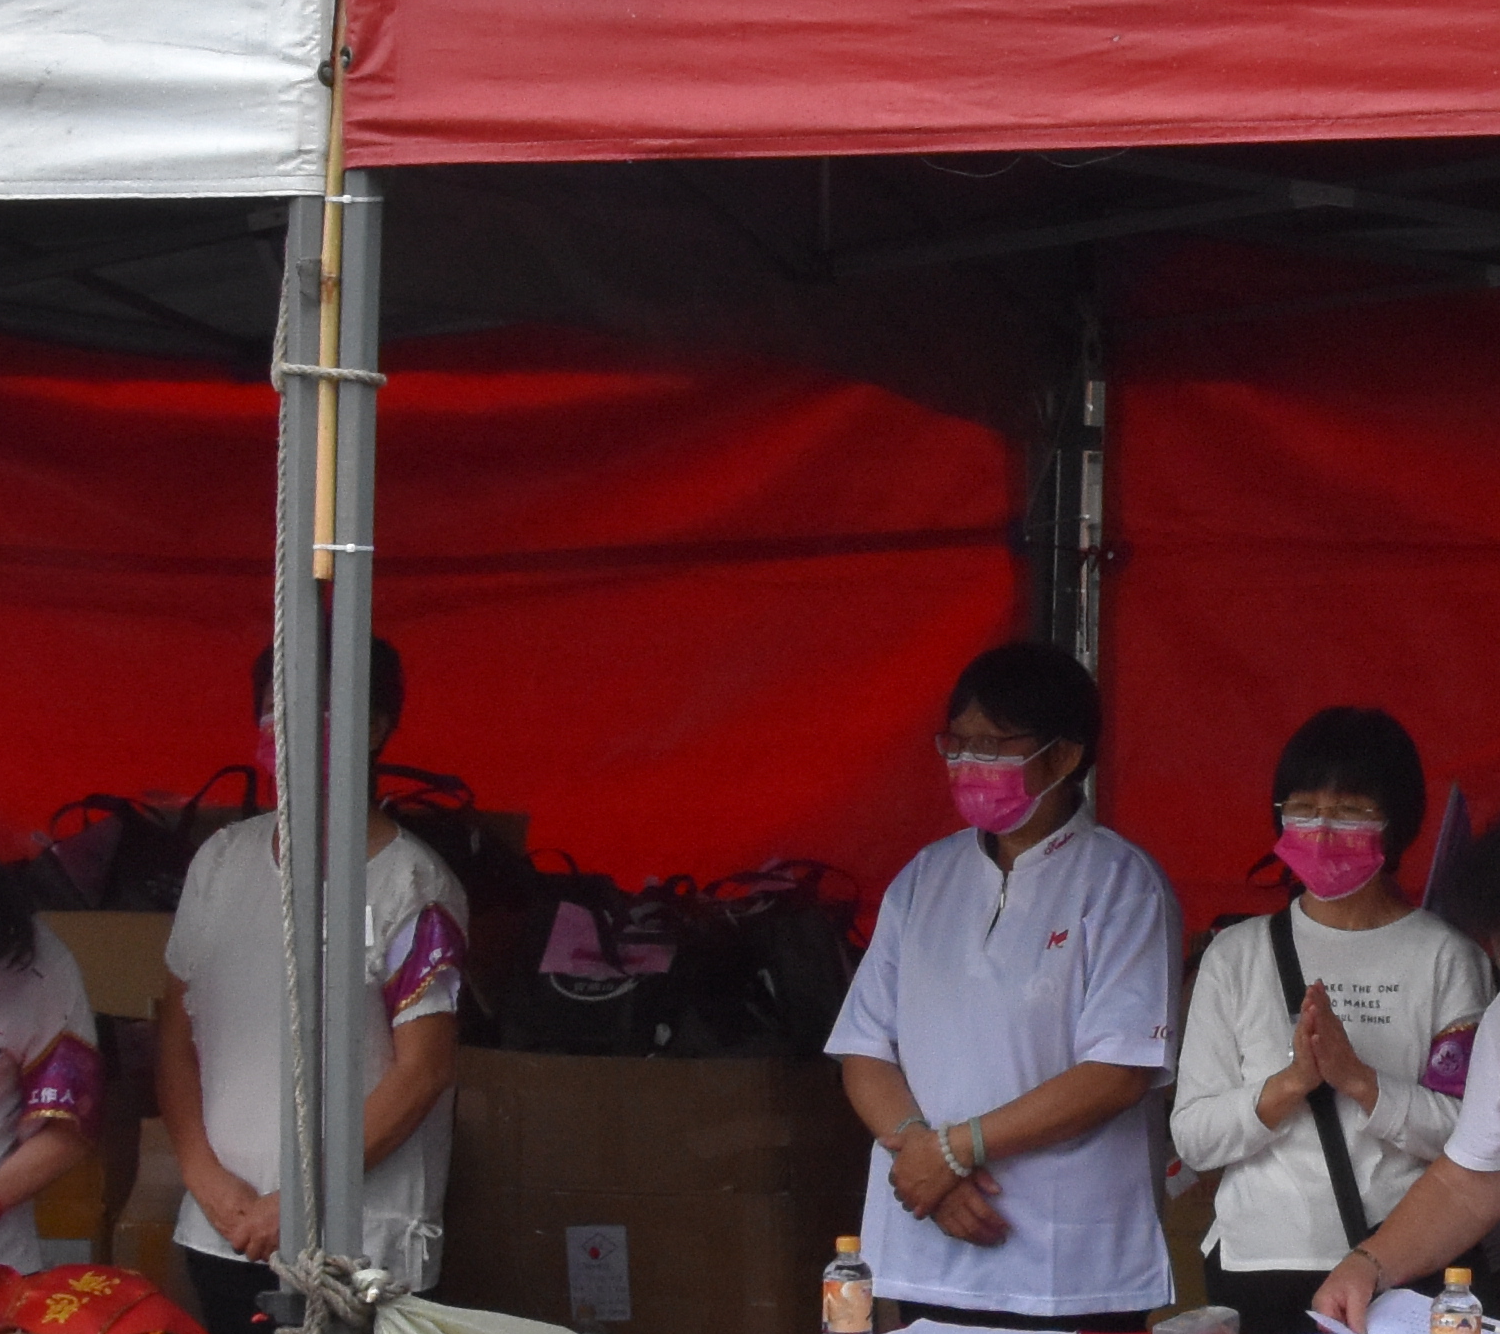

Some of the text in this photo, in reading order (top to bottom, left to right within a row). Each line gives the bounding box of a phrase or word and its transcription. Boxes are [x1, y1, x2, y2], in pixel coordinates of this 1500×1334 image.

[1352, 985, 1371, 993] THE
[1378, 985, 1399, 993] ONE
[1344, 999, 1381, 1009] MAKES
[1360, 1015, 1391, 1024] SHINE
